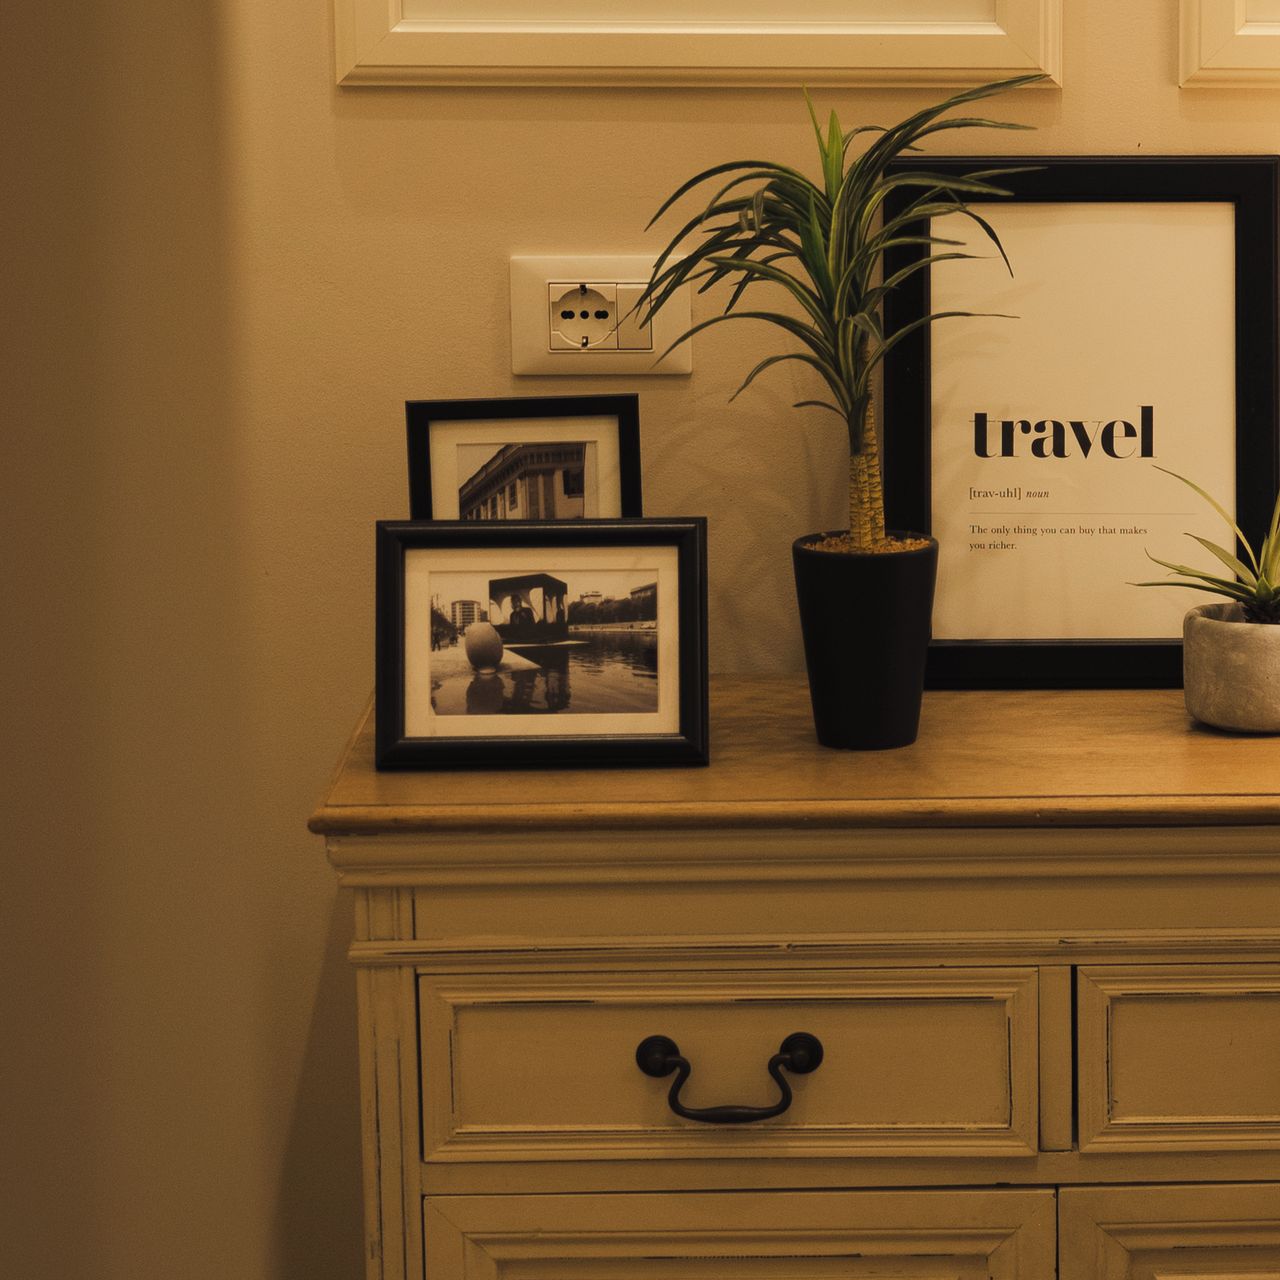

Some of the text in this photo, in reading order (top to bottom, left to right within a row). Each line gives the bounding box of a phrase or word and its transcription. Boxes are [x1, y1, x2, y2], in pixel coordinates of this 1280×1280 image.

[968, 405, 1158, 460] travel
[969, 487, 1050, 500] [trav-uhl] noun
[969, 525, 988, 535] The
[990, 525, 1011, 537] only
[1013, 525, 1038, 537] thing
[1040, 528, 1057, 537] you
[1078, 525, 1095, 537] buy
[1098, 525, 1117, 535] that
[1119, 525, 1148, 535] makes
[969, 540, 1017, 552] you richer.
